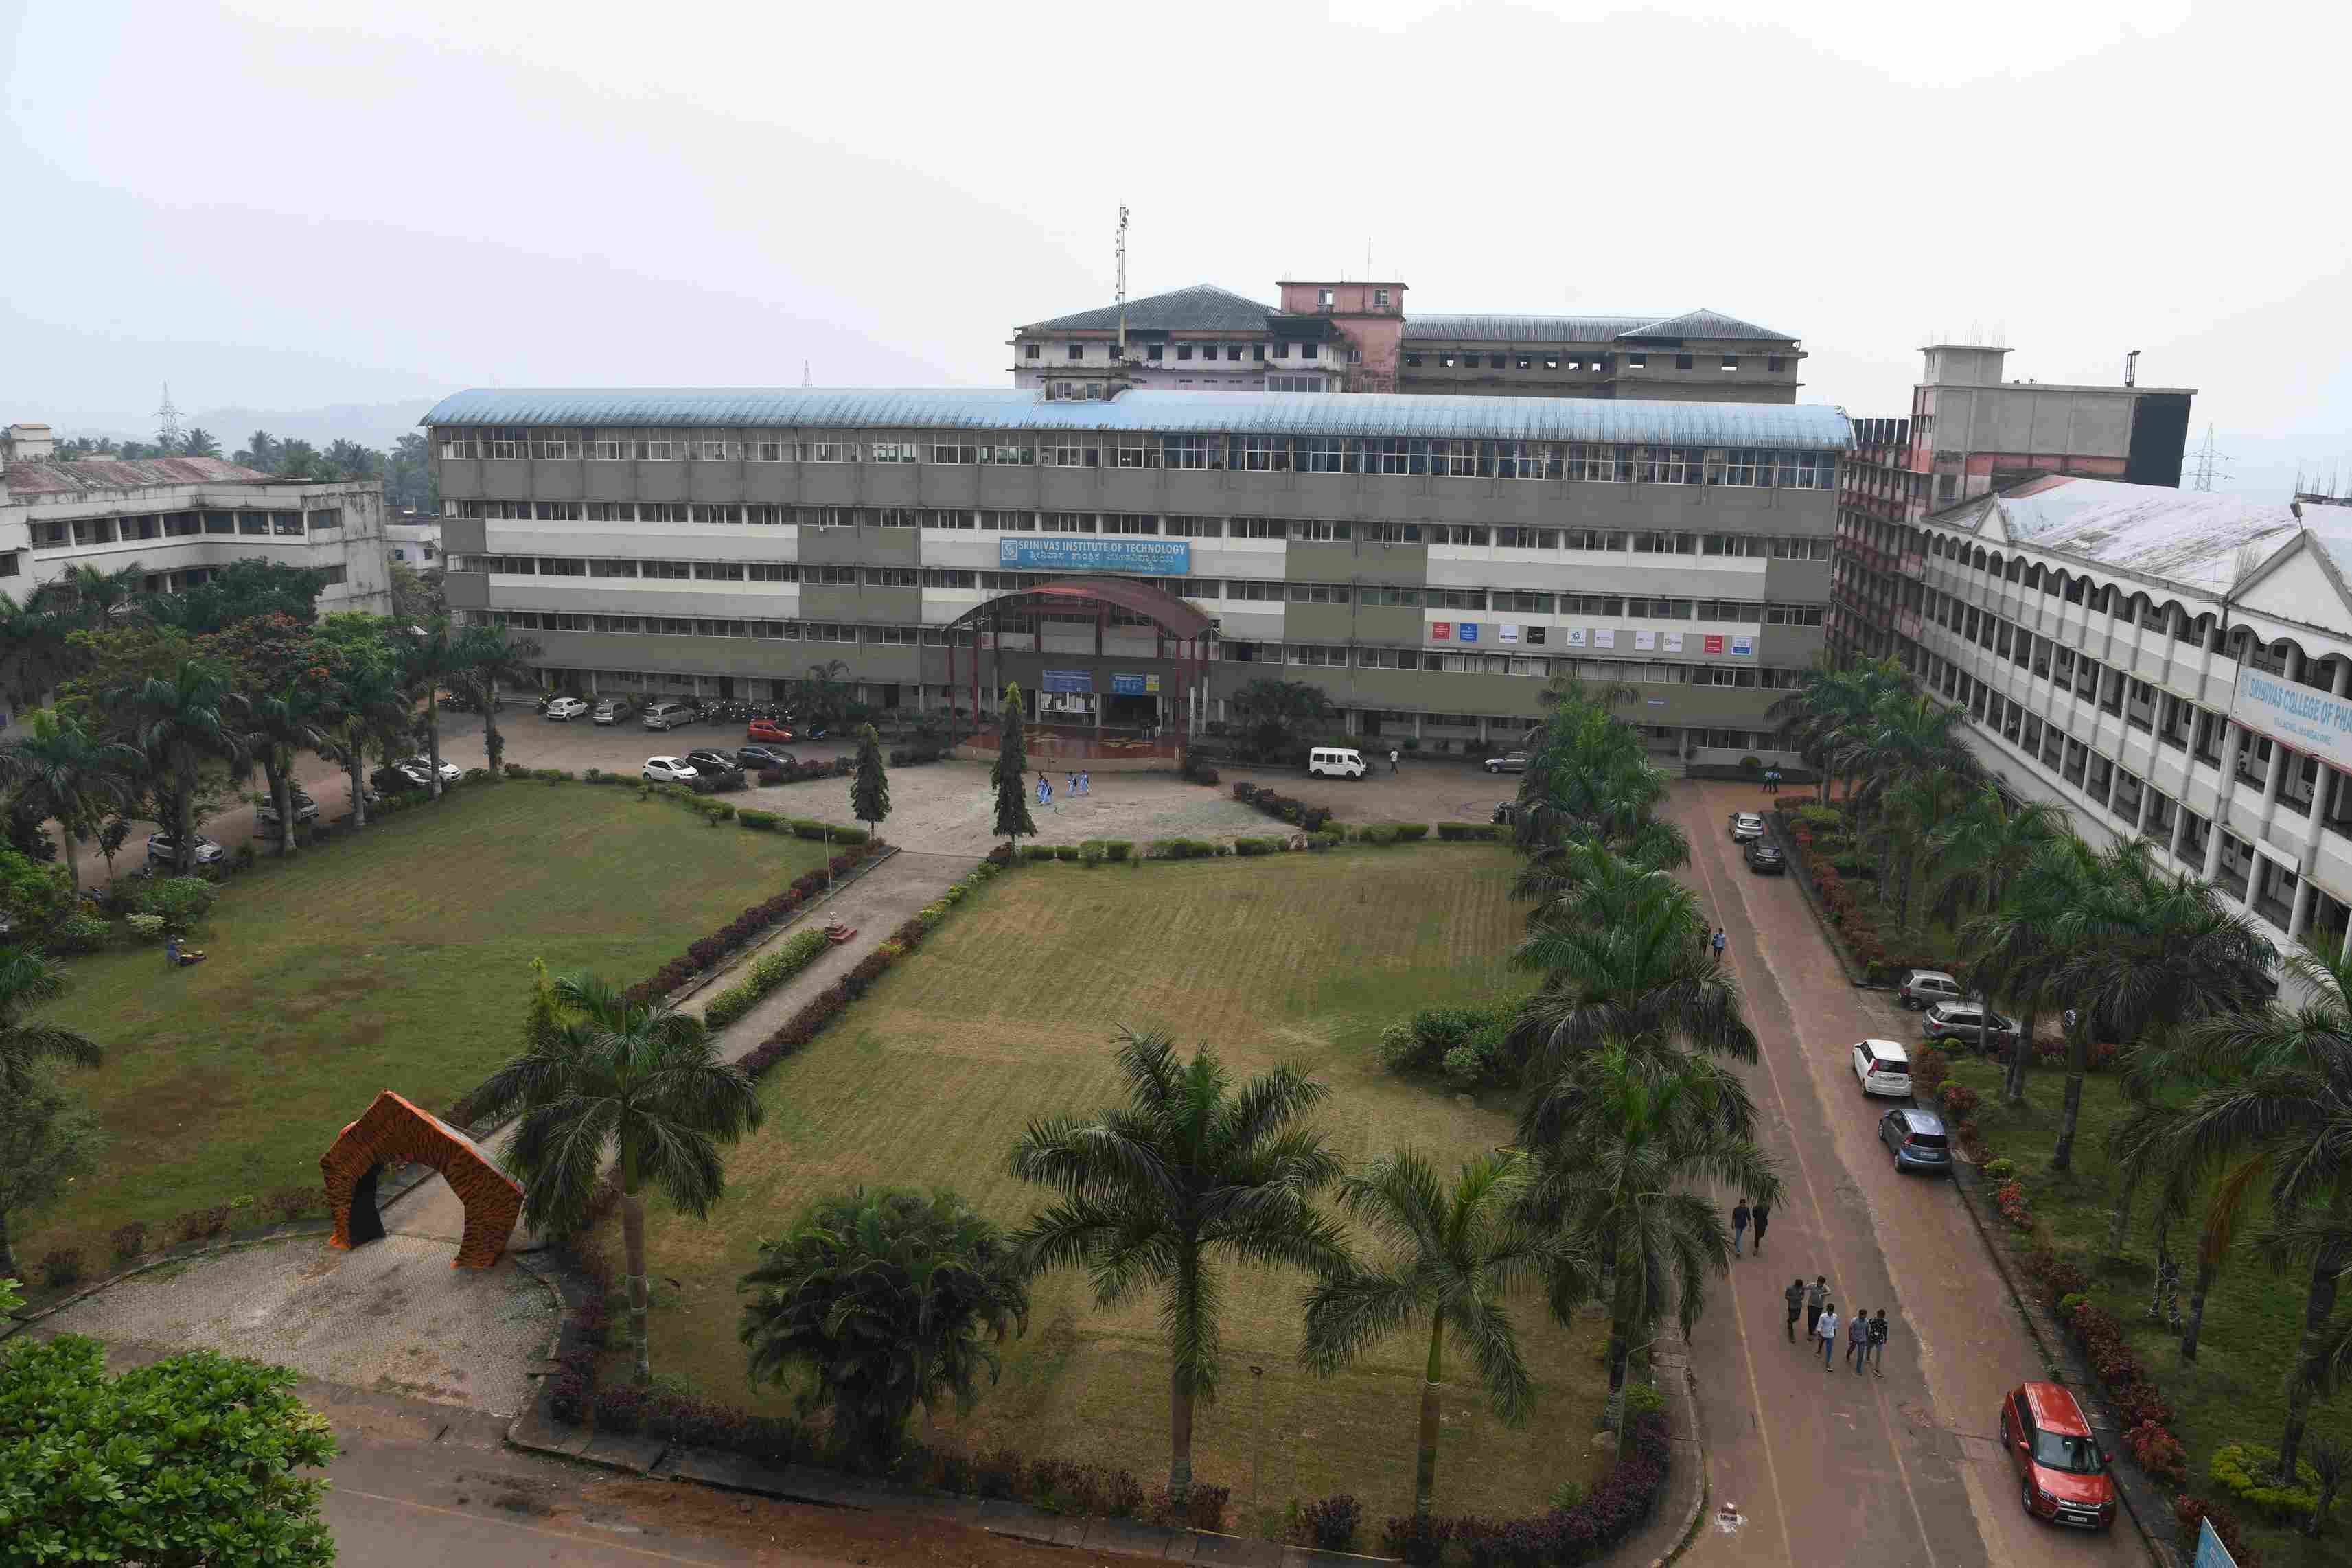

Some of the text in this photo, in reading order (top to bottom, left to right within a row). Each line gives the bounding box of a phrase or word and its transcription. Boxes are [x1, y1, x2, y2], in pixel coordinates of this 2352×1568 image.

[1018, 540, 1186, 555] SRINIVAS INSTITUTE OF TECHNOLOGY
[2248, 678, 2283, 708] SRINIVAS
[2283, 689, 2321, 721] COLLEGE
[2320, 702, 2334, 726] OF
